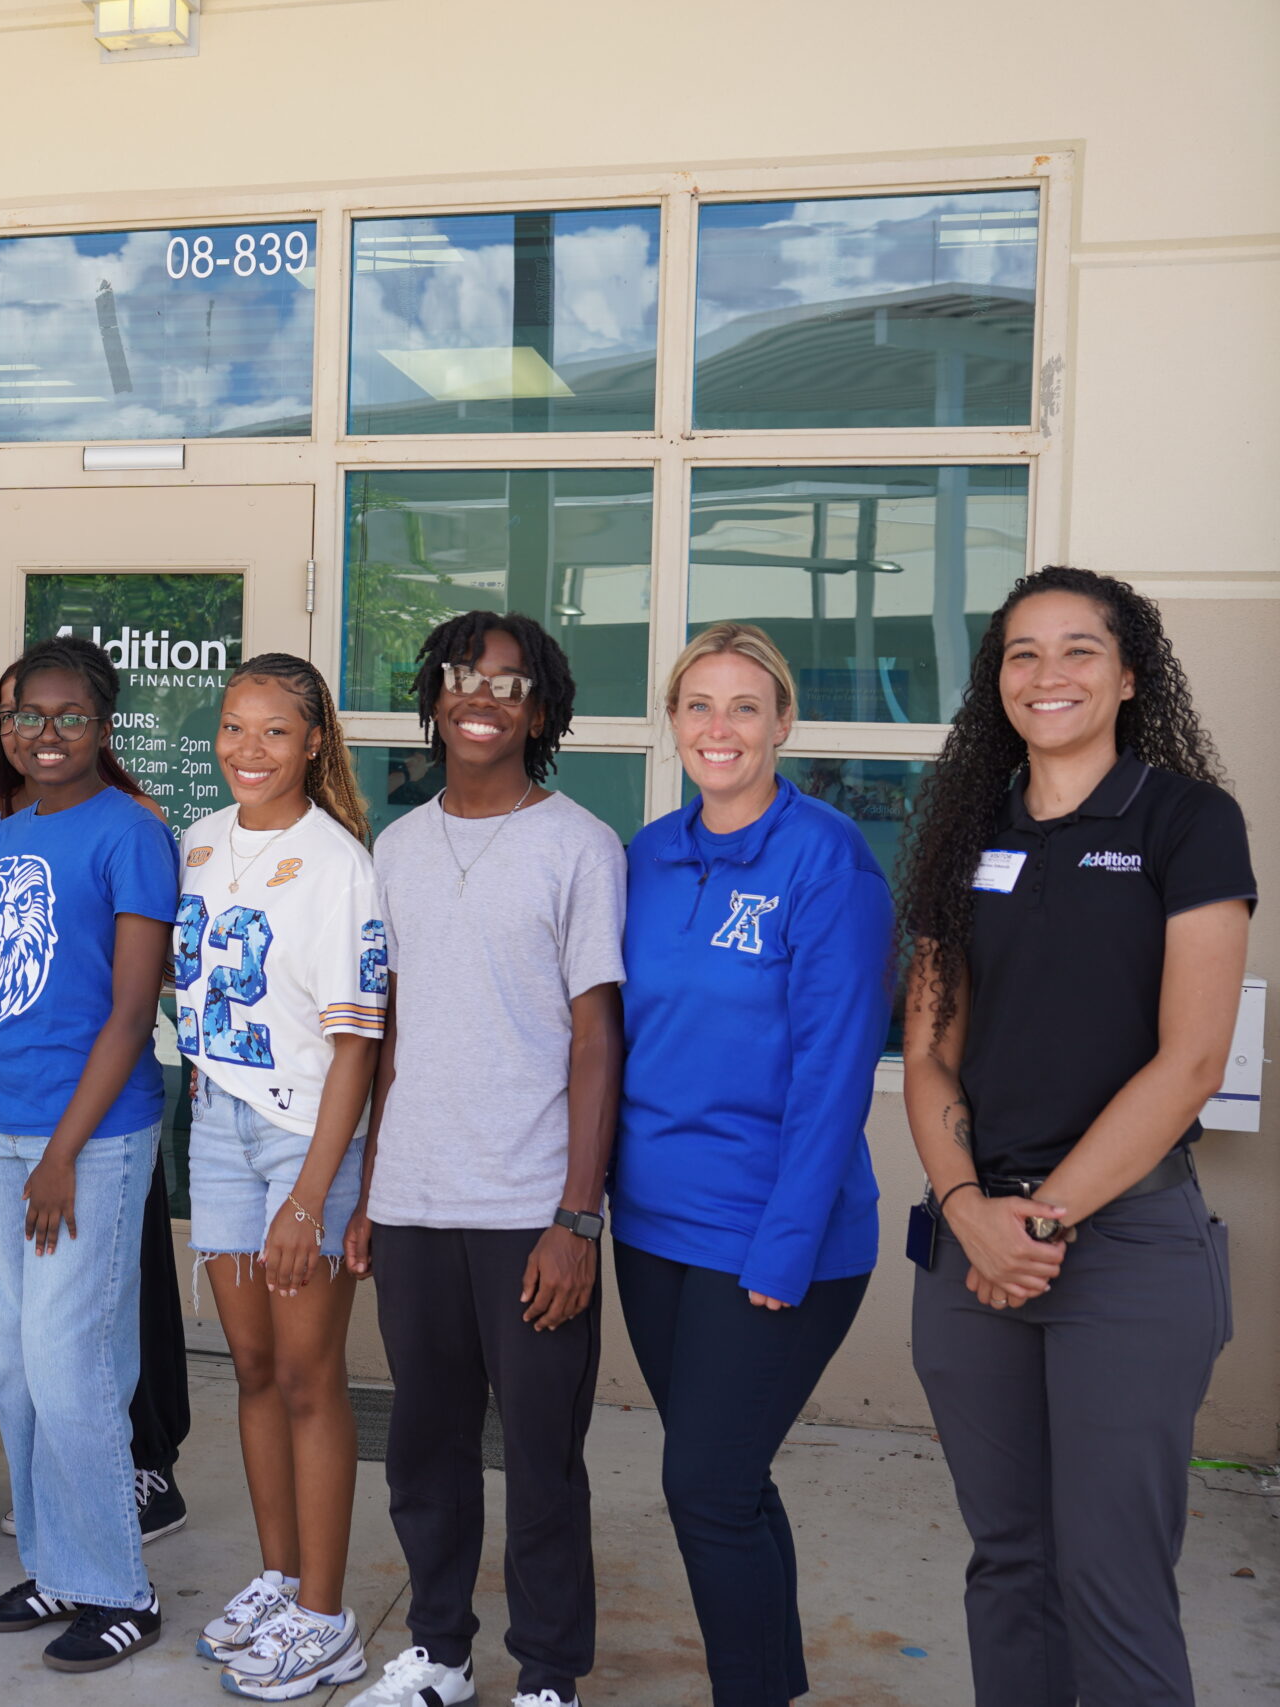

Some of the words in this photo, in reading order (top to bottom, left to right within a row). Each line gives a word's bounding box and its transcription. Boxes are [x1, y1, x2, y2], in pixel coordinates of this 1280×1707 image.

[166, 231, 308, 279] 08-839
[55, 626, 226, 671] dition
[130, 674, 226, 688] FINANCIAL
[111, 712, 160, 729] OURS:
[180, 736, 211, 756] 2pm
[116, 757, 168, 774] 0:12am
[181, 759, 212, 778] 2pm
[189, 781, 219, 801] 1pm
[1078, 851, 1142, 868] Addition
